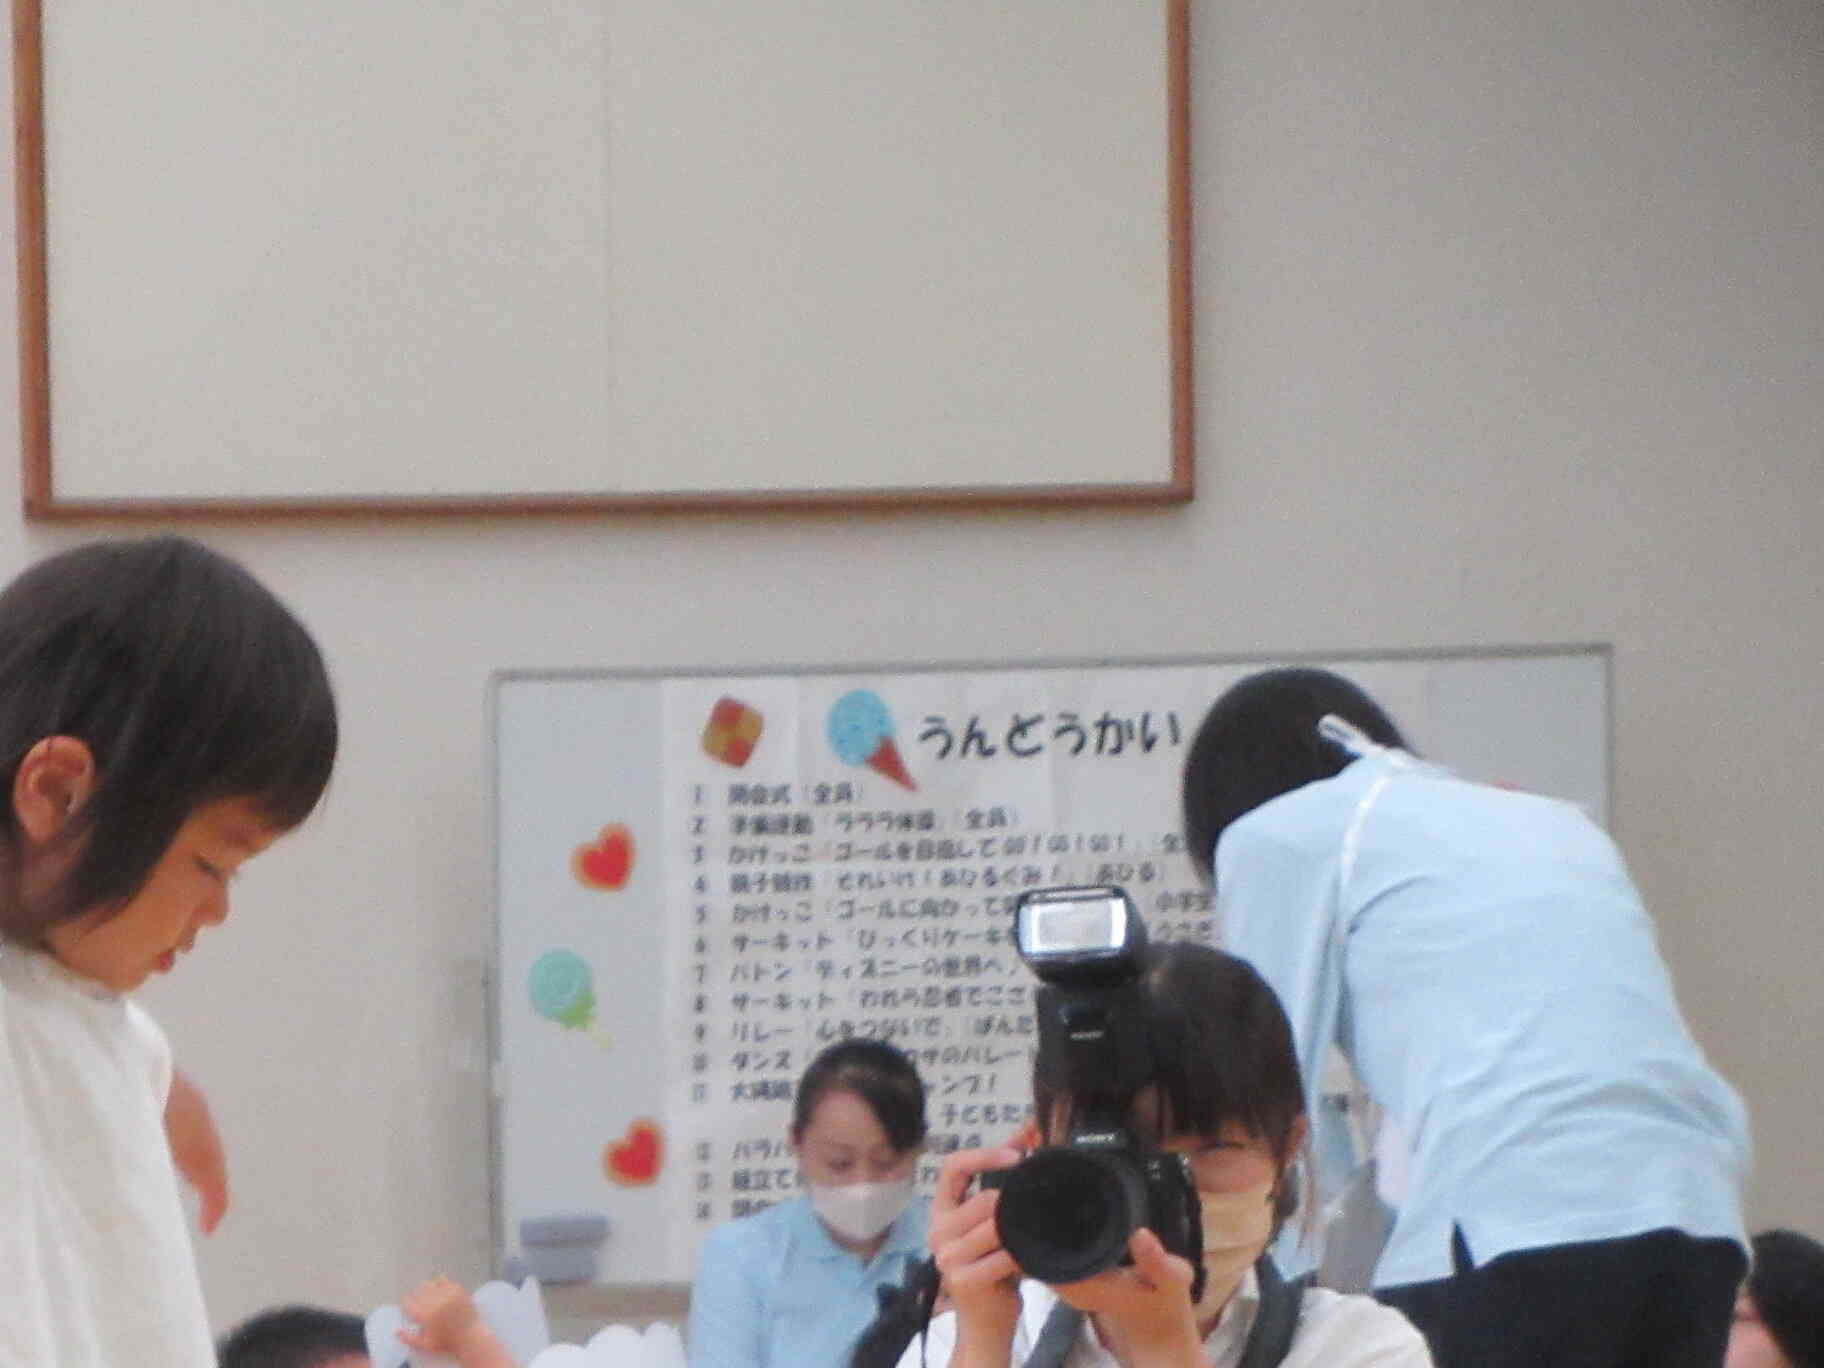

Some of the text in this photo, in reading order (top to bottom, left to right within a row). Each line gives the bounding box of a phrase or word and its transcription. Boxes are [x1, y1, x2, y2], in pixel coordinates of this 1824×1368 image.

[918, 712, 1180, 760] うんどうかい
